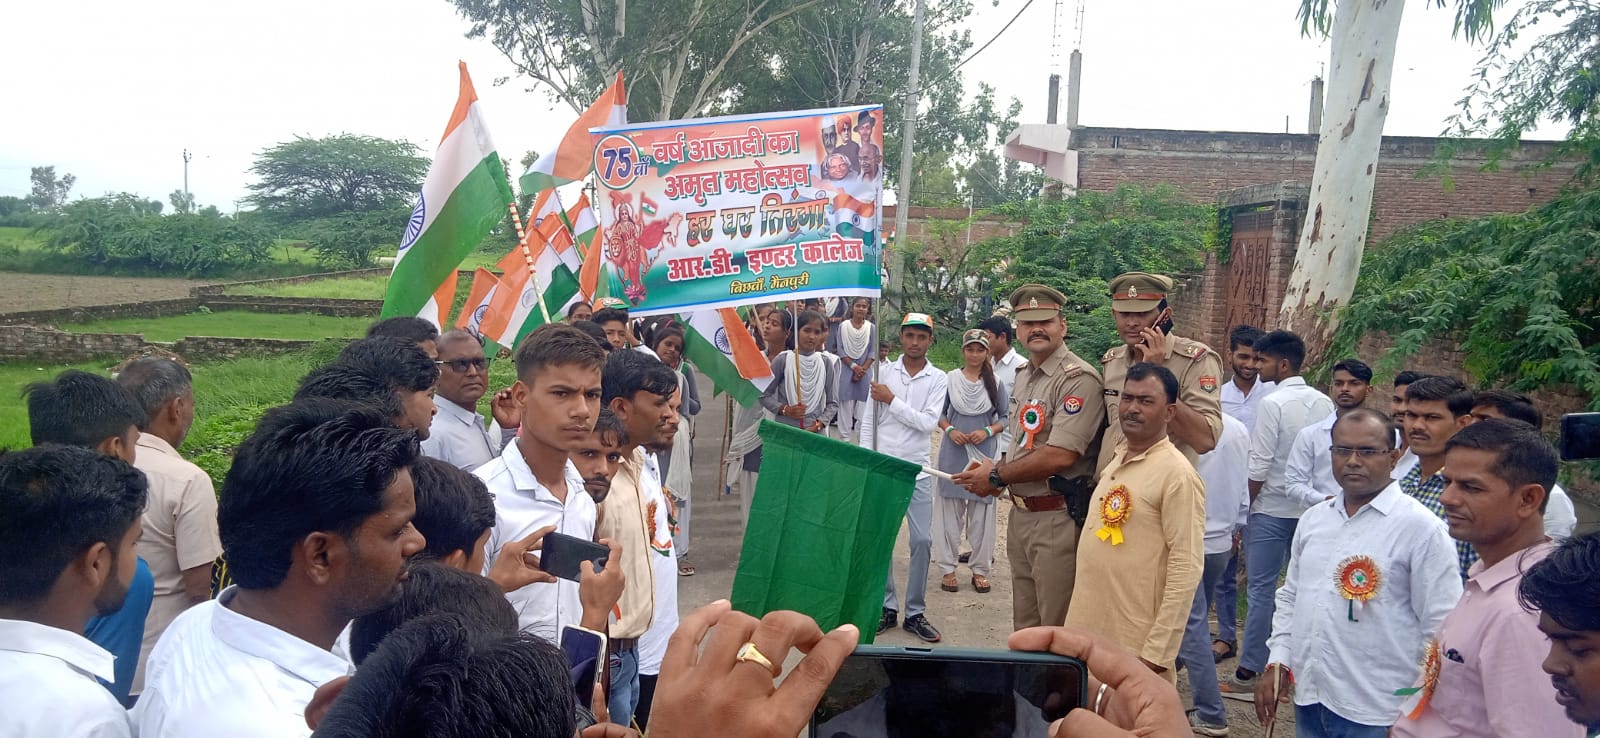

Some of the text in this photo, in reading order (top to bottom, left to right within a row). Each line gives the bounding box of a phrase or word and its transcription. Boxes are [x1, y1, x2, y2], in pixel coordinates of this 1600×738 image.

[652, 132, 685, 164] वर्ष
[688, 126, 765, 162] आजादी
[766, 131, 799, 154] का
[664, 159, 811, 206] अमृत महोत्सव
[685, 188, 830, 247] हर घर तिरंगा
[746, 243, 798, 274] इण्टर
[801, 234, 865, 265] कालेज
[770, 271, 810, 290] मैनपुरी
